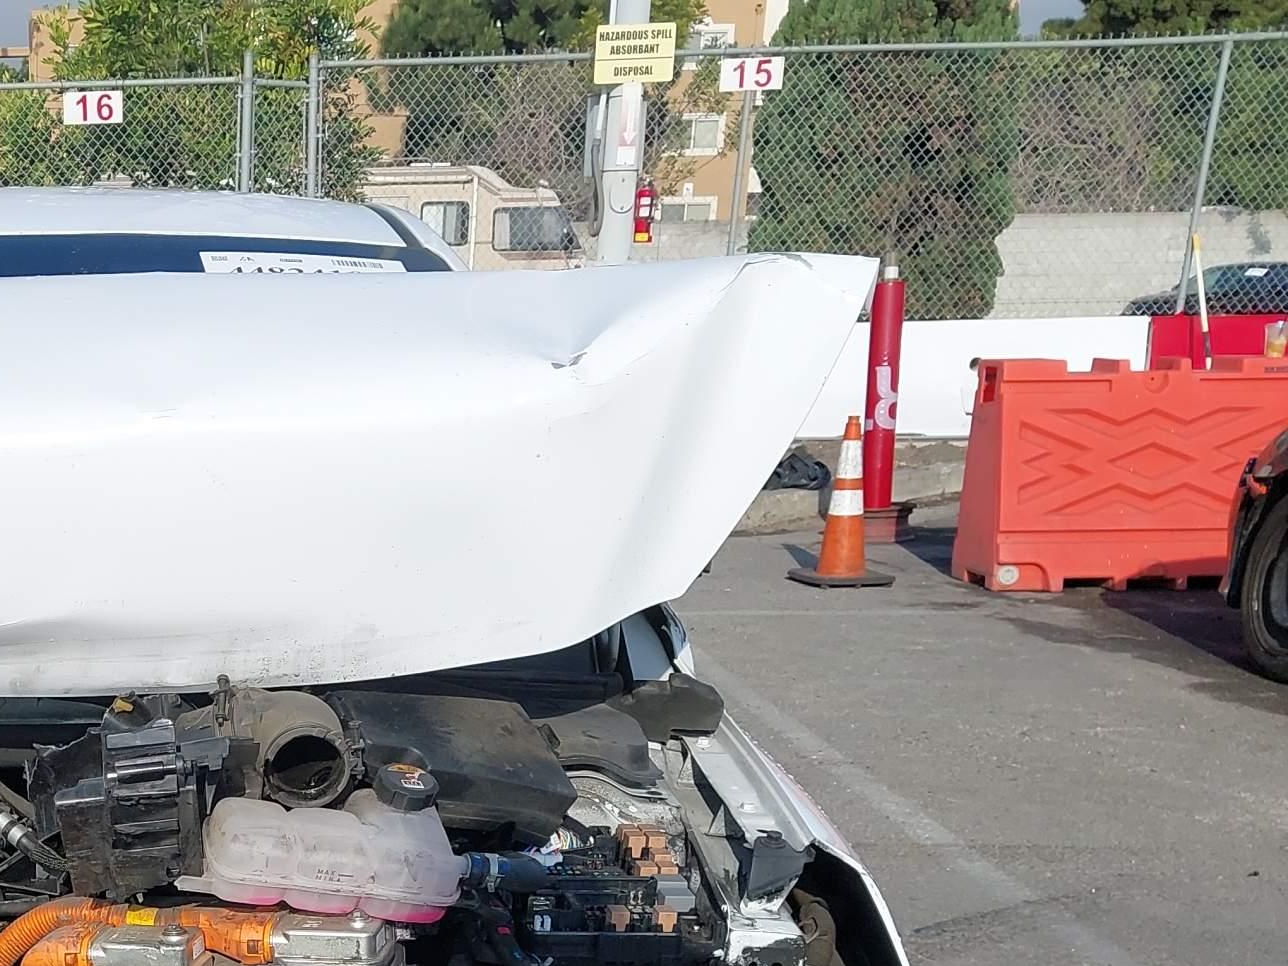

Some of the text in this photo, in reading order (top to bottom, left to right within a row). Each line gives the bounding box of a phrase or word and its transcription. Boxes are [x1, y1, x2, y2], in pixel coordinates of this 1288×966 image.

[599, 28, 673, 42] HAZARDOUS SPILL
[609, 44, 660, 56] ABSORBANT
[613, 65, 654, 77] DISPOSAL
[732, 59, 773, 89] 15
[76, 94, 114, 122] 16
